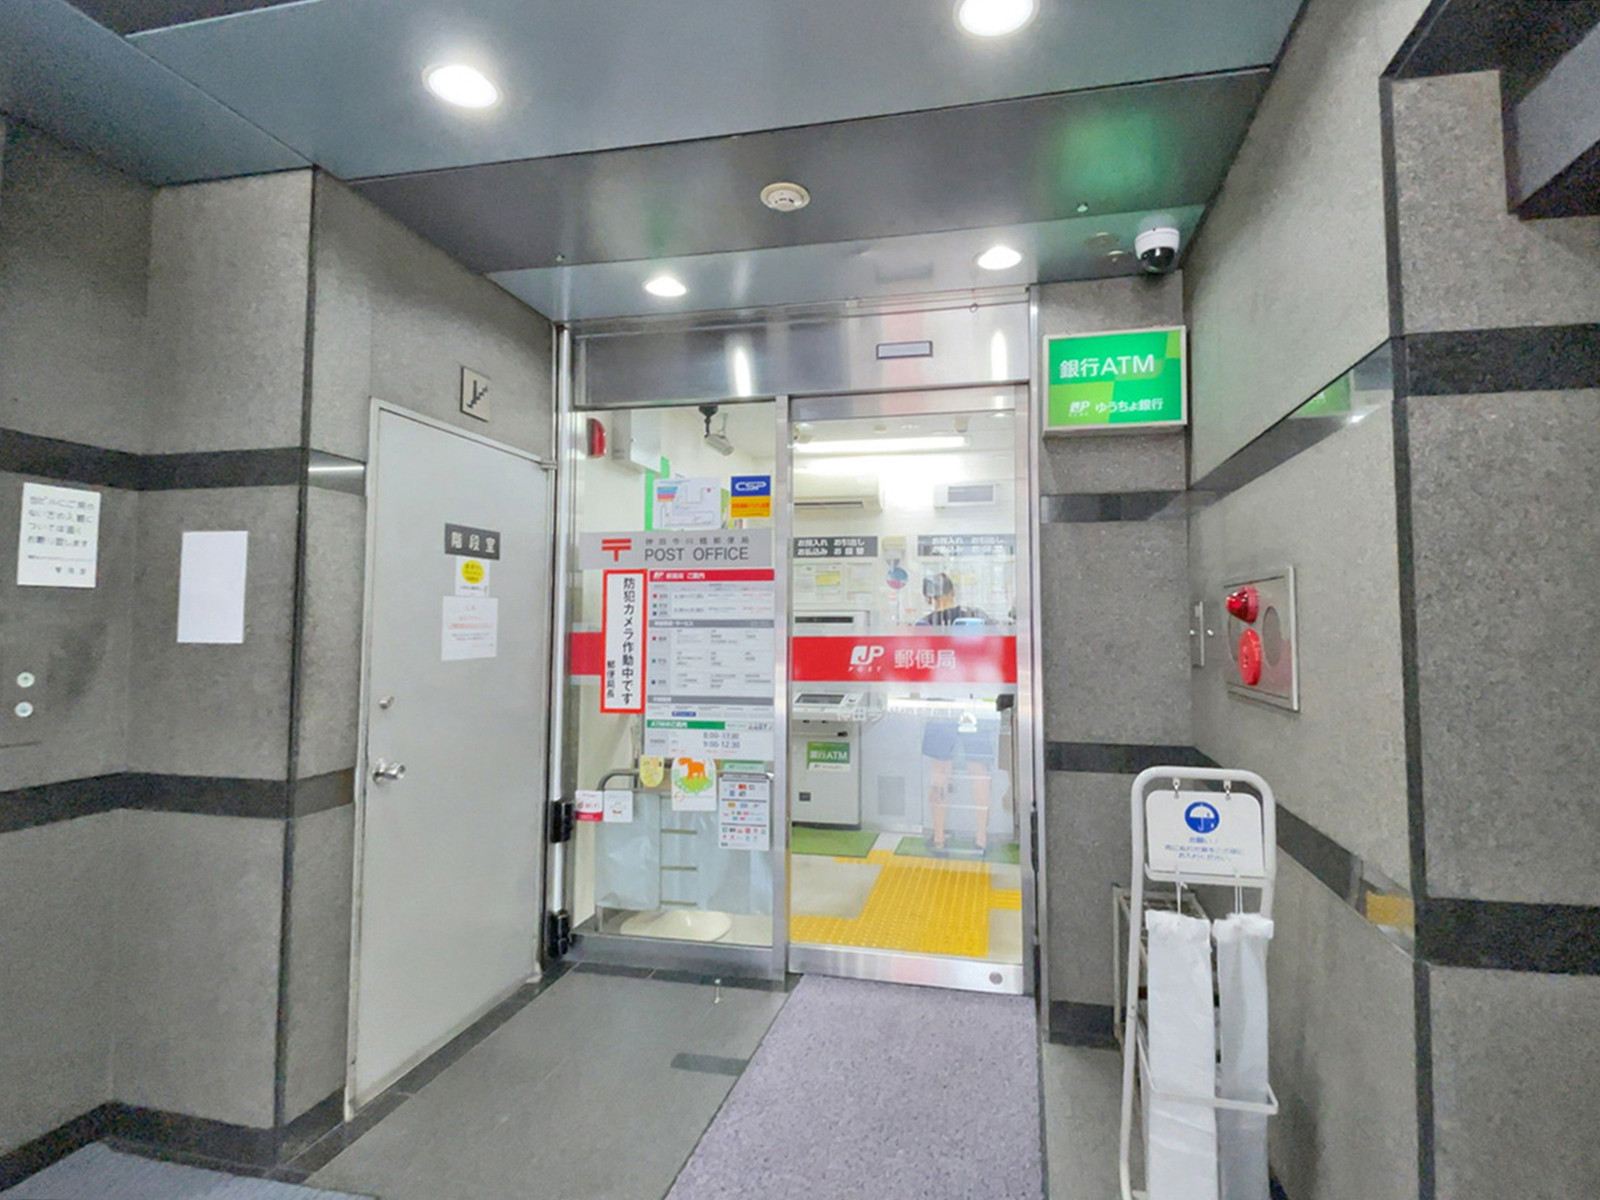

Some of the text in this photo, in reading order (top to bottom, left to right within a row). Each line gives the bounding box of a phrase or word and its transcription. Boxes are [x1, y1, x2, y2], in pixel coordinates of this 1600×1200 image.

[1059, 354, 1155, 379] 銀行ATM
[1095, 398, 1164, 413] ゆうちょ銀行
[735, 481, 767, 491] CSP
[451, 532, 497, 553] 階段室
[644, 546, 749, 561] POST OFFICE
[621, 577, 636, 705] 防犯カメラ作動中です
[849, 645, 956, 669] JP 郵便局
